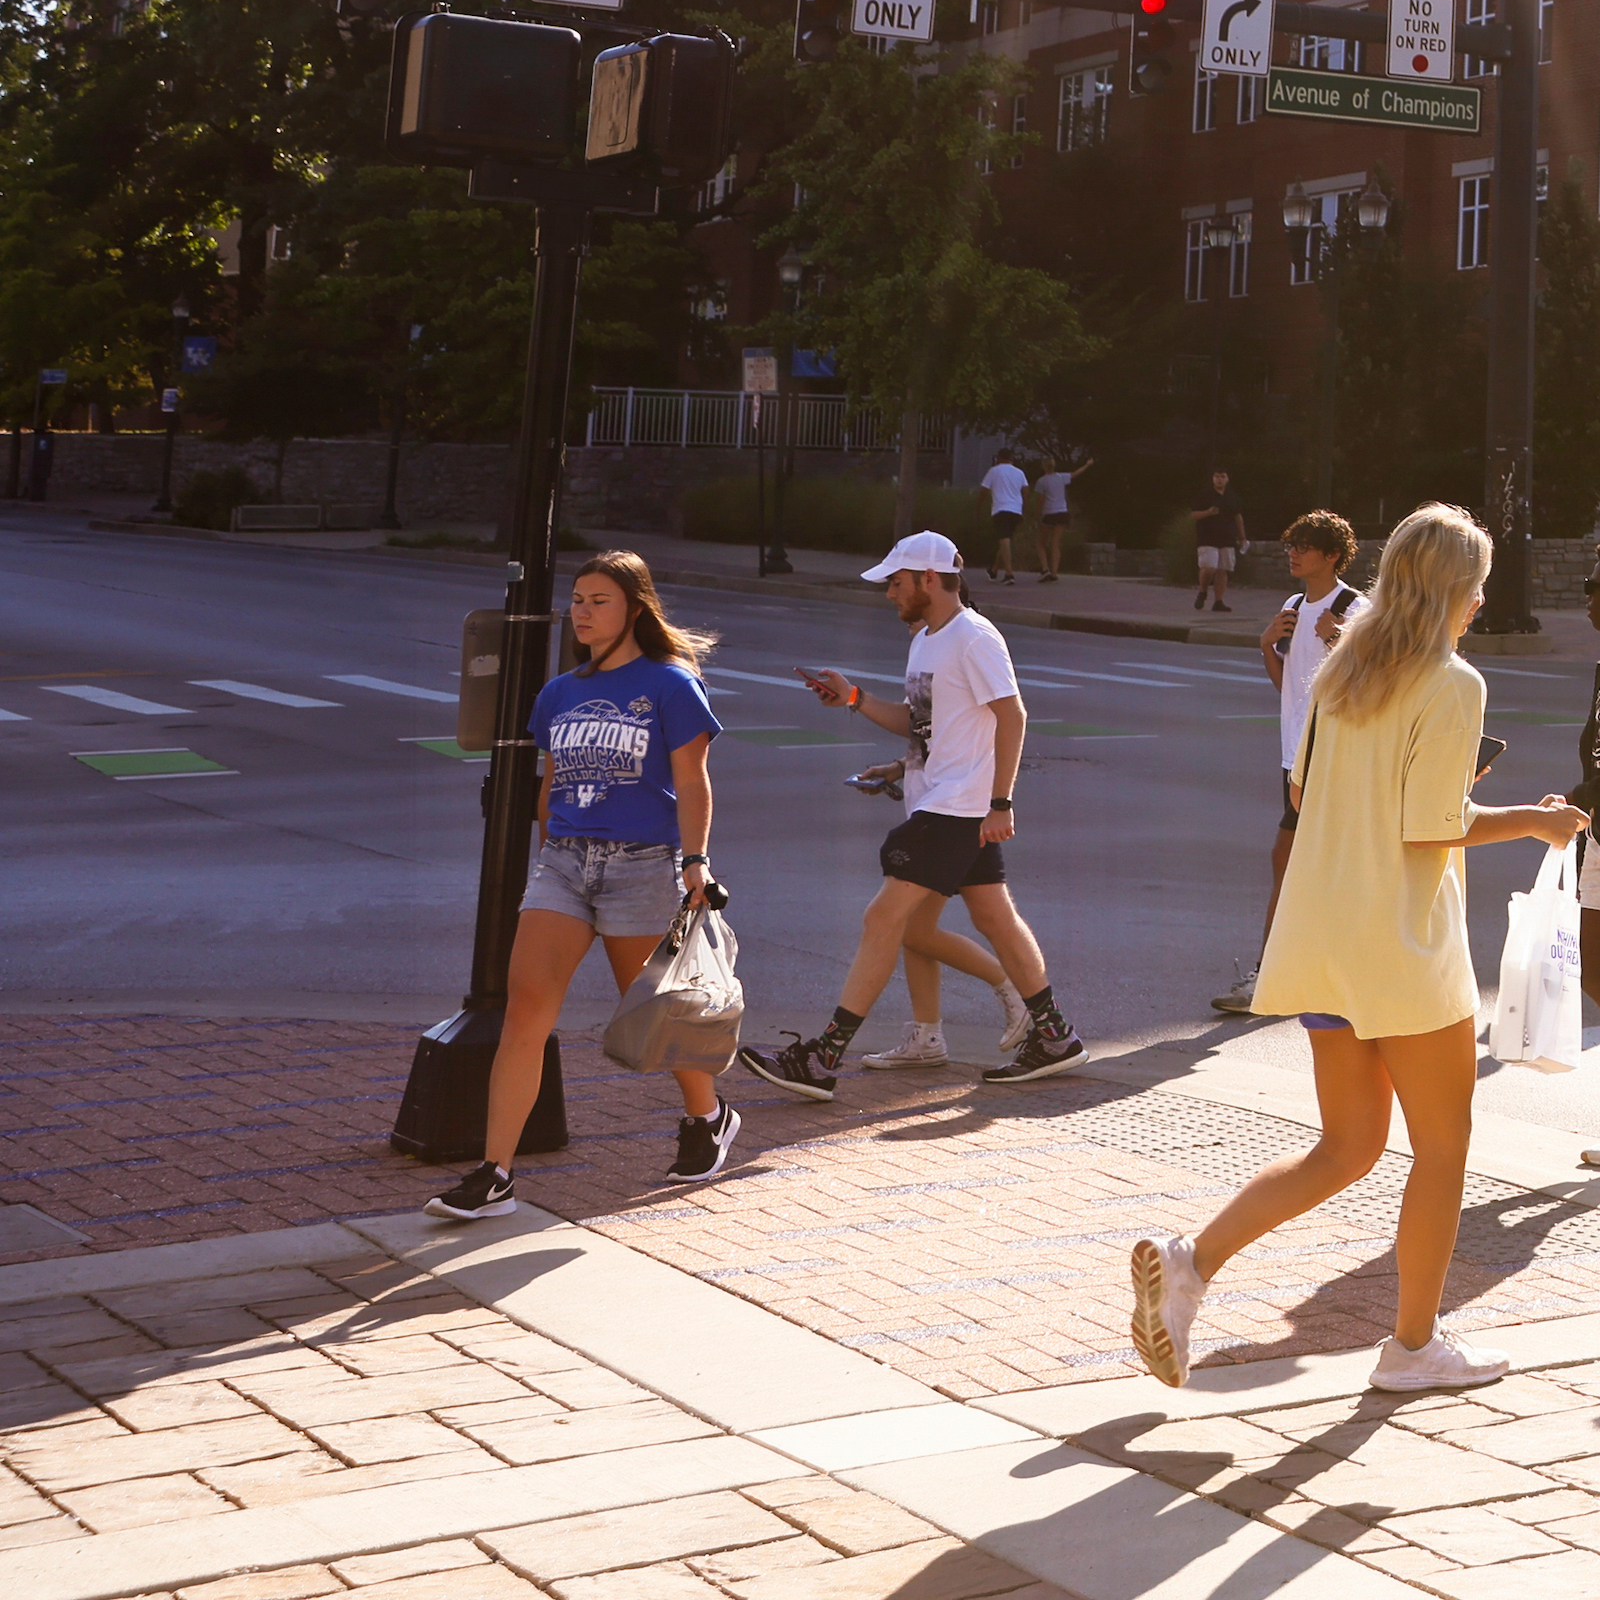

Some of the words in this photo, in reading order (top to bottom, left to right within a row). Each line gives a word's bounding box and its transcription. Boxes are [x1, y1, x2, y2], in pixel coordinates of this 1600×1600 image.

[865, 0, 922, 30] ONLY
[1409, 0, 1432, 16] NO
[1404, 18, 1440, 35] TURN
[1395, 35, 1415, 50] ON
[1420, 37, 1447, 53] RED
[1211, 46, 1261, 67] ONLY
[1272, 79, 1340, 107] Avenue
[1352, 88, 1370, 110] of
[1381, 90, 1474, 121] Champions
[549, 721, 650, 758] HAMPIONS
[551, 745, 632, 773] ENTUCKY
[555, 770, 613, 784] WILDCAS
